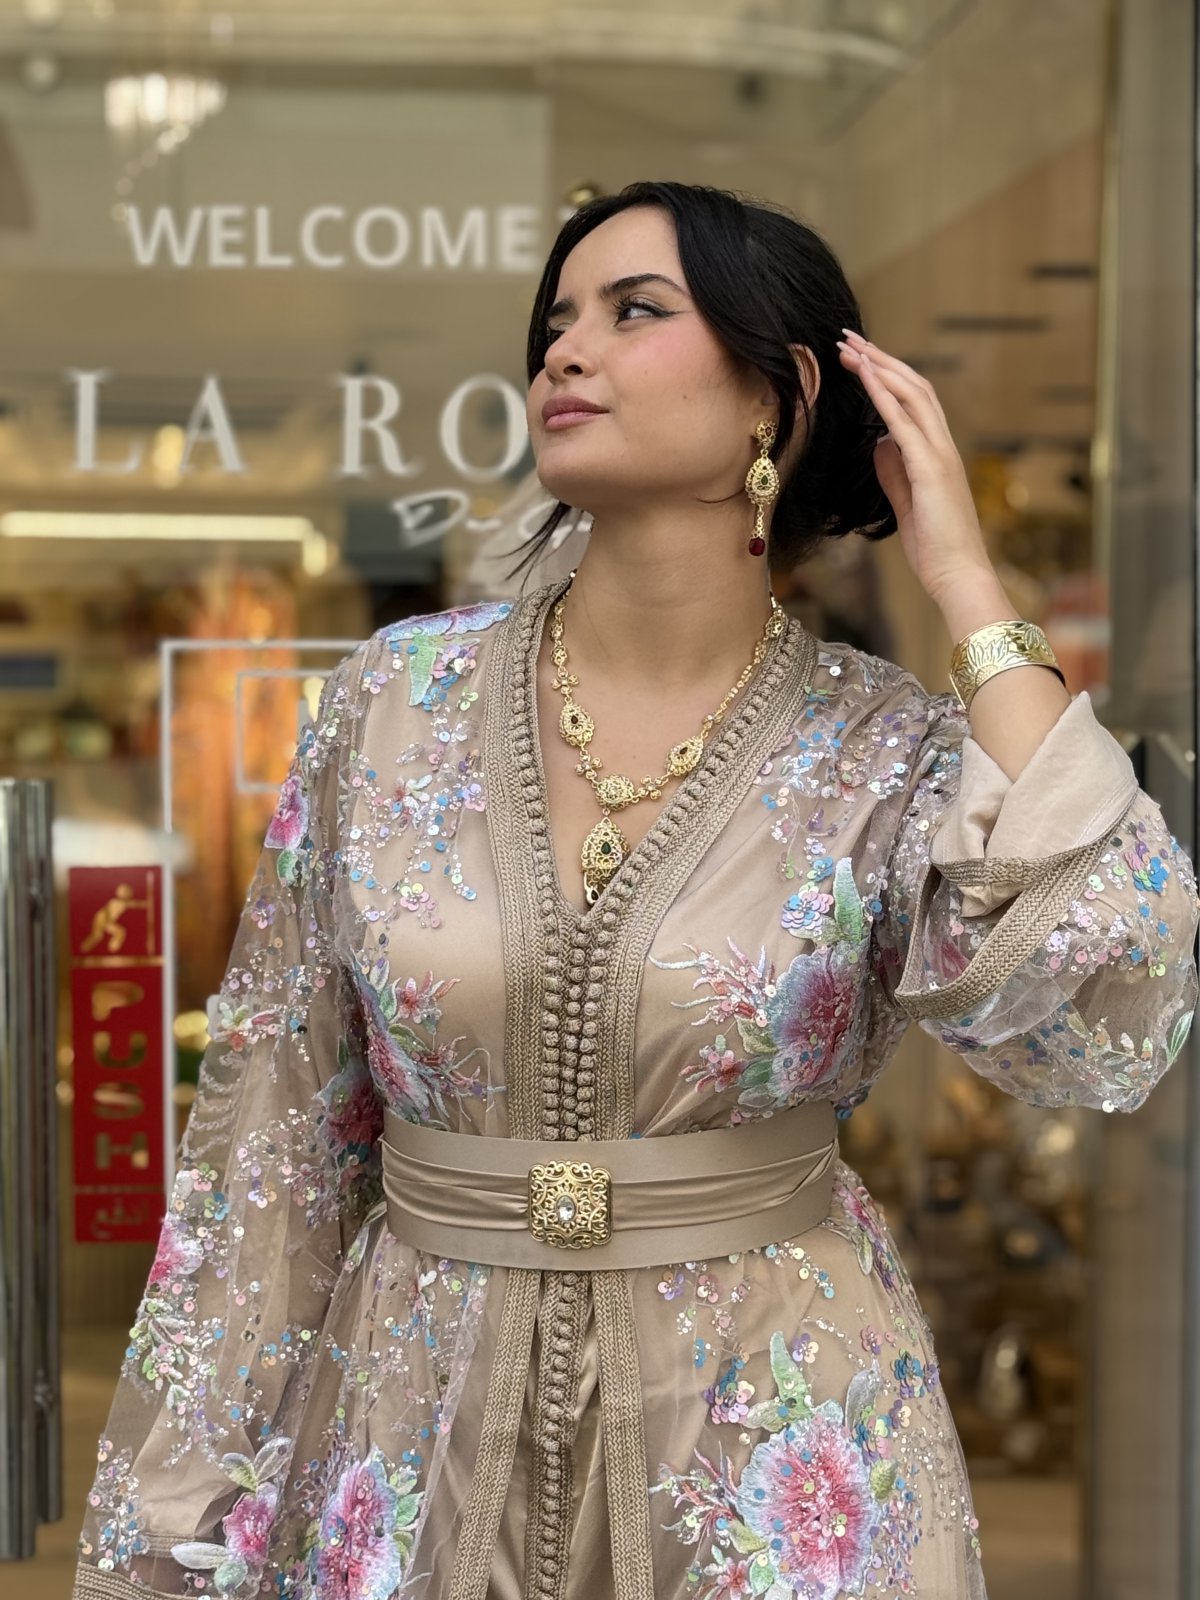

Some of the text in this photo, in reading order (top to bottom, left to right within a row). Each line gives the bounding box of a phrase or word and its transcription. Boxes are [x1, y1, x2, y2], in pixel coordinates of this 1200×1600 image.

[126, 205, 540, 270] WELCOME
[68, 368, 532, 482] LA RO
[91, 980, 149, 1170] PUSH
